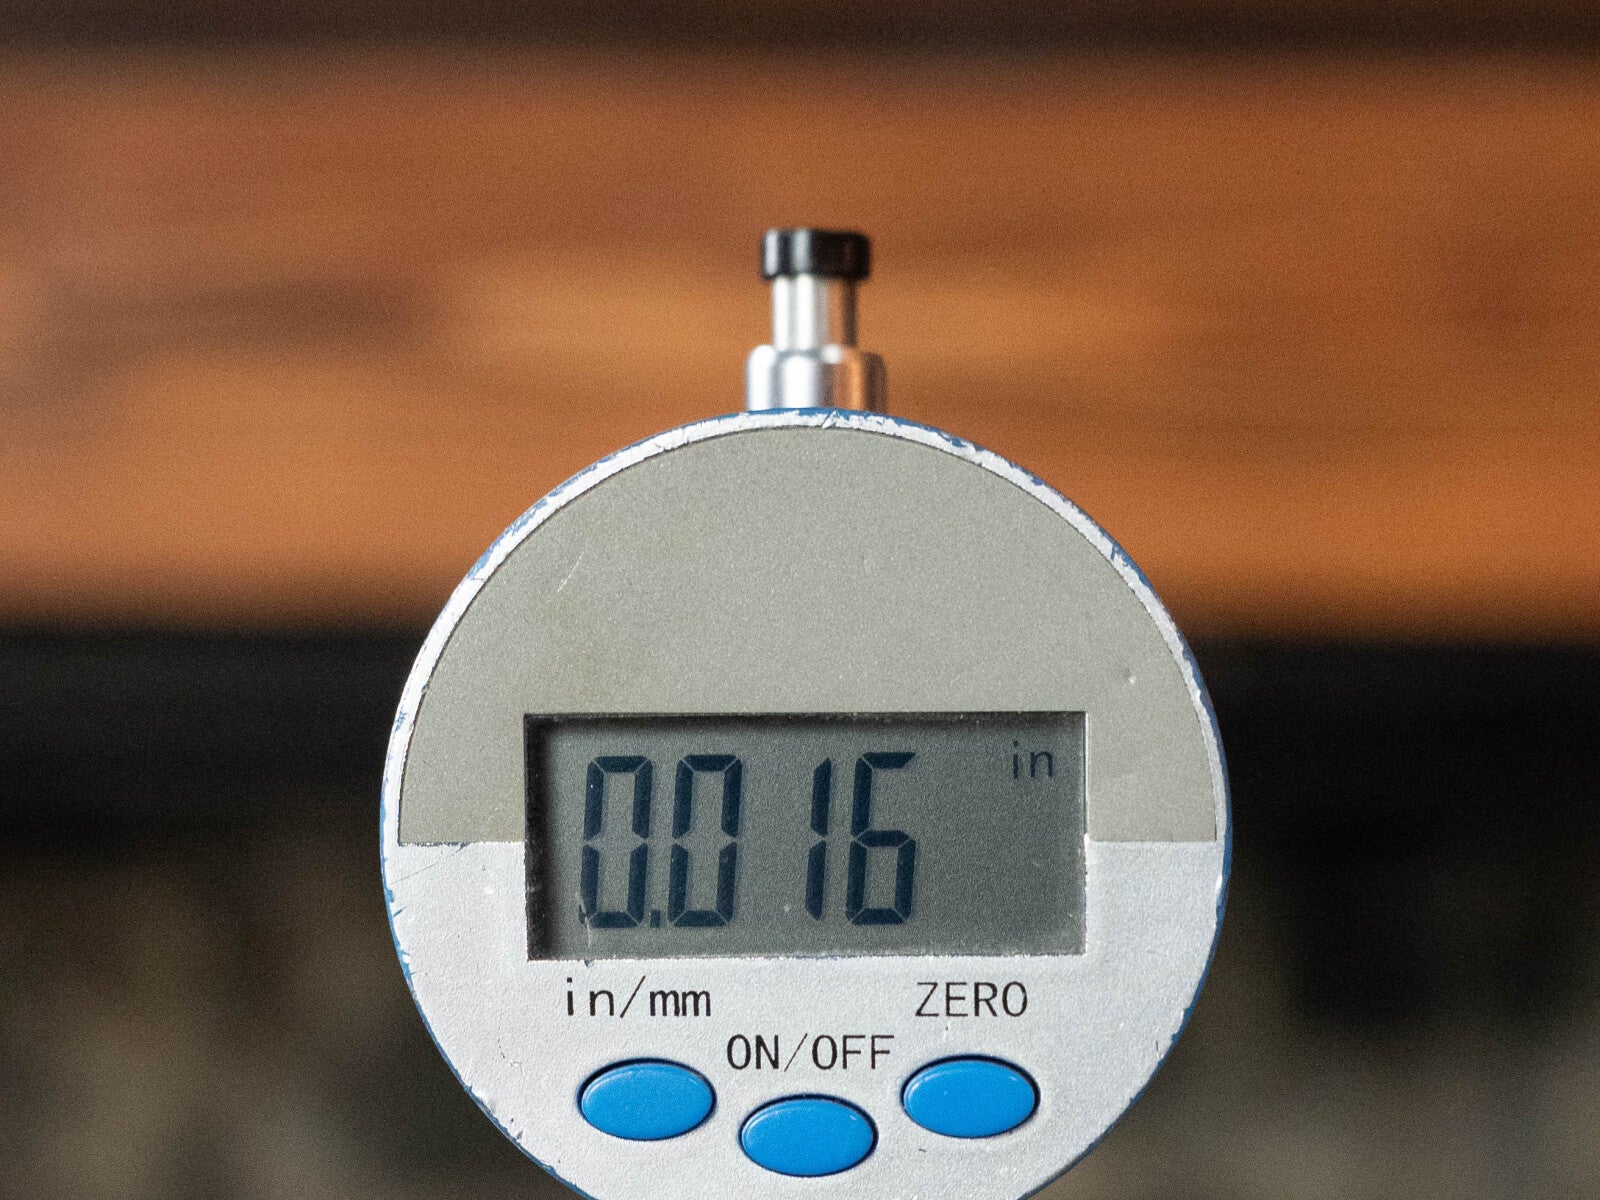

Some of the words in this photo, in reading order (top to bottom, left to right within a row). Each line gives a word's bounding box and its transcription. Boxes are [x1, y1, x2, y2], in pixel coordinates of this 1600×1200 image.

[579, 751, 918, 929] 0.016
[1011, 739, 1056, 780] in
[565, 975, 713, 1019] in/mm
[914, 980, 1029, 1018] ZERO
[725, 1033, 896, 1073] ON/OFF
